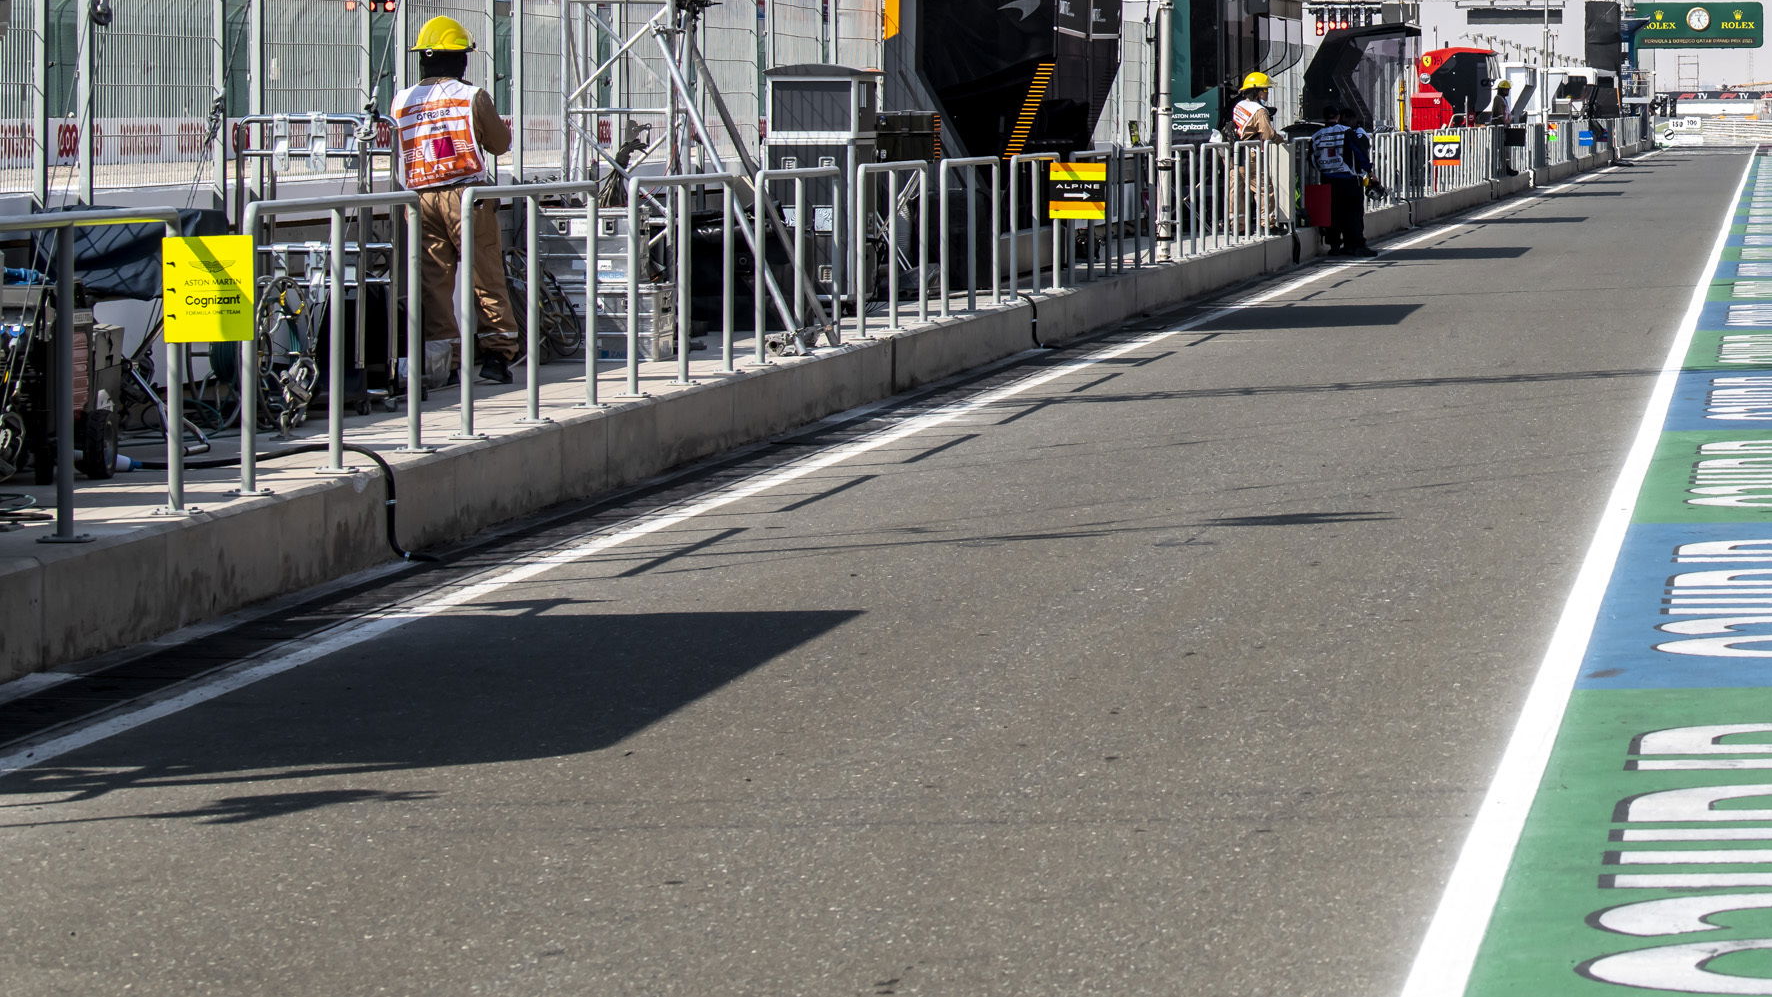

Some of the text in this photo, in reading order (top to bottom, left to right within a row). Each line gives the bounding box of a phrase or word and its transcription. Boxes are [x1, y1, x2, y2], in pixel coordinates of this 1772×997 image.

[1171, 123, 1209, 132] Cognizant
[212, 278, 242, 286] MARTIN
[185, 294, 241, 308] Cognizant
